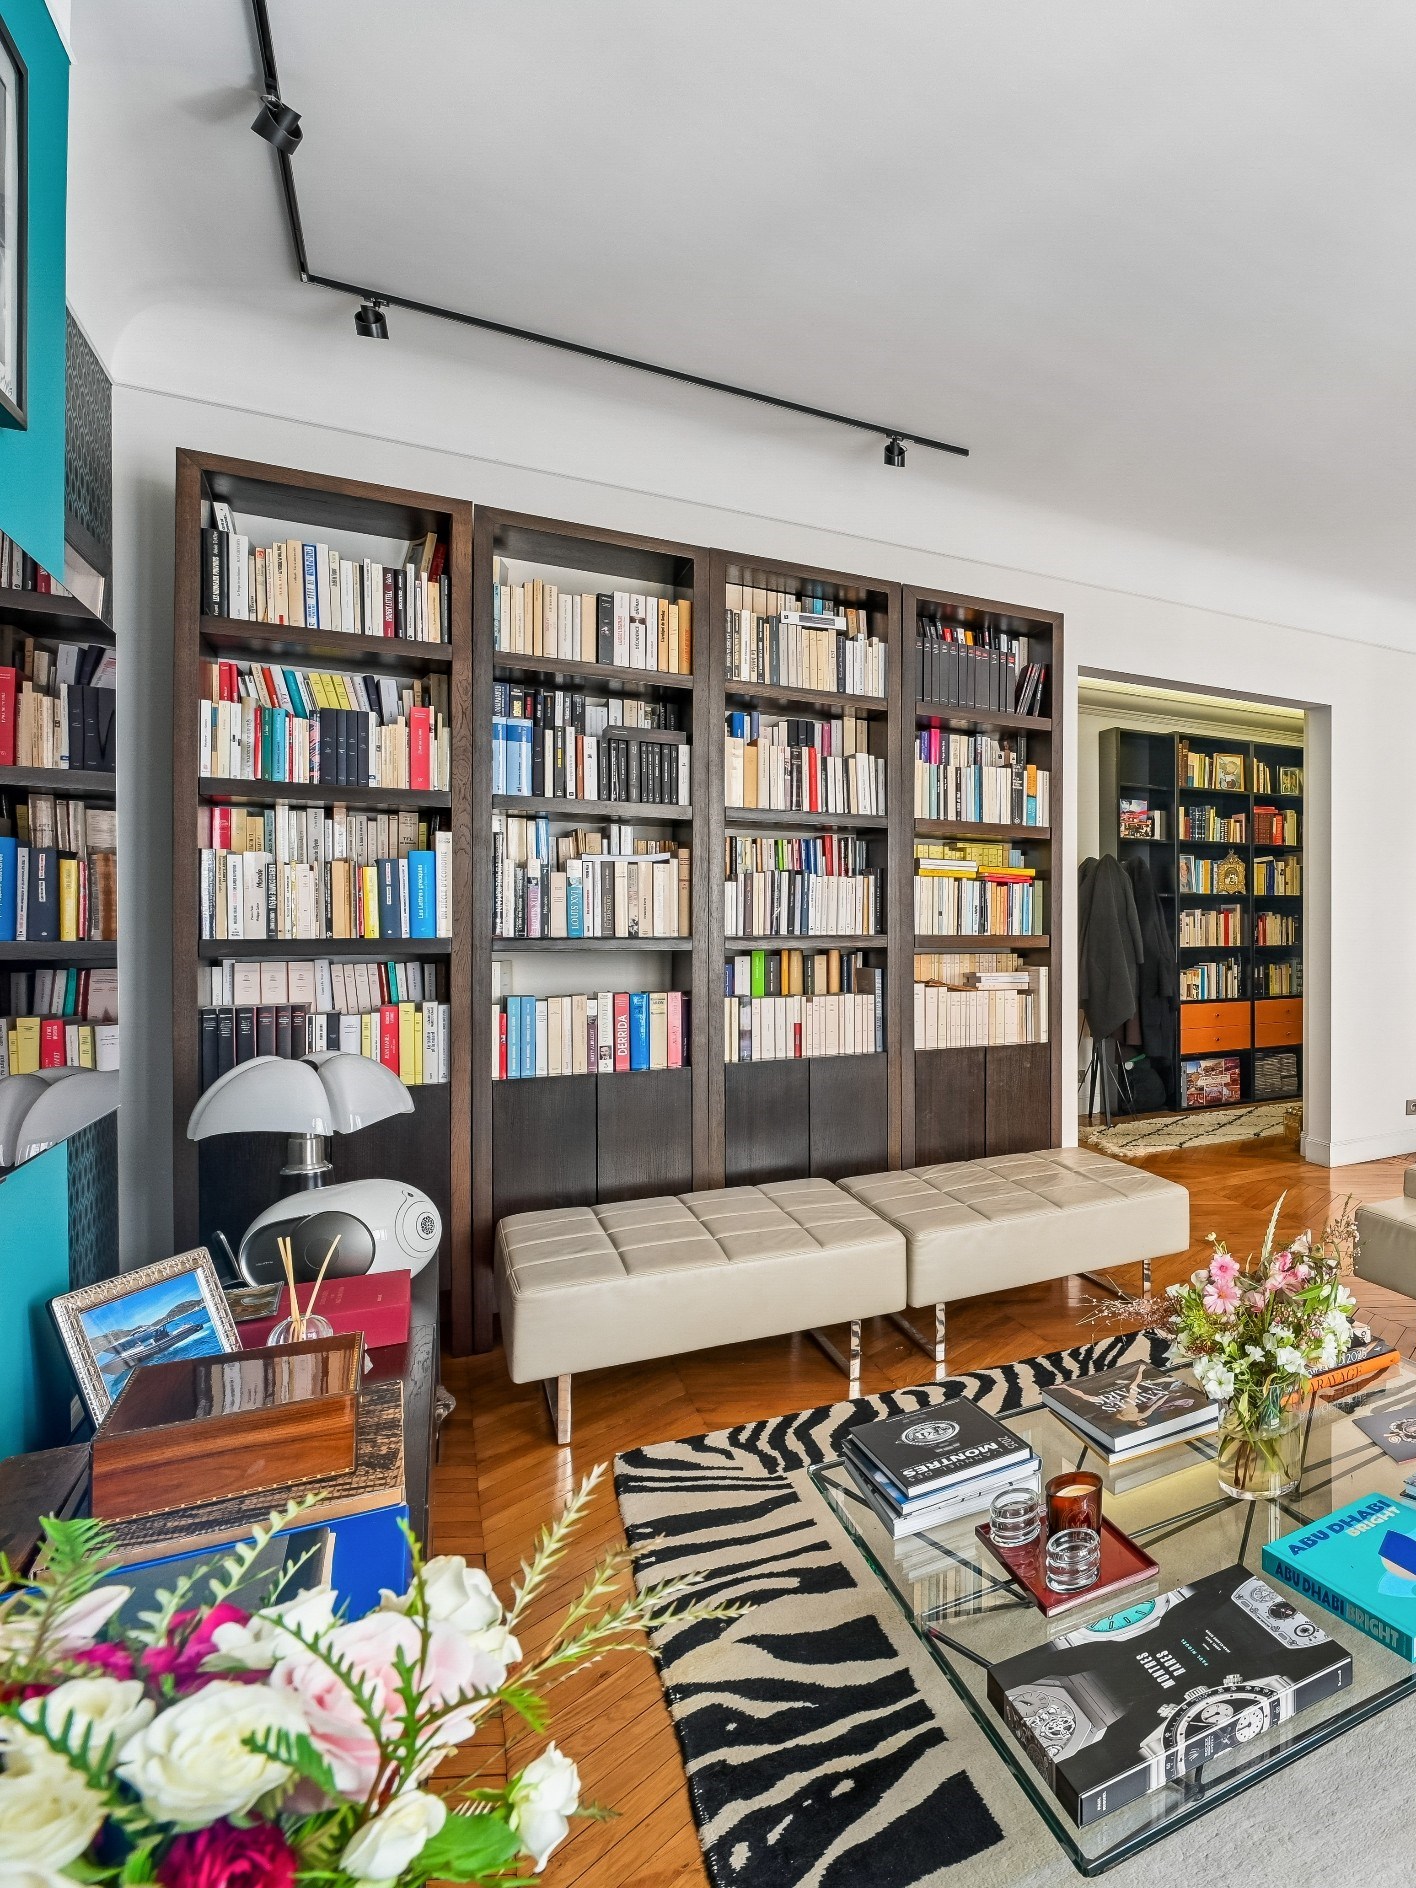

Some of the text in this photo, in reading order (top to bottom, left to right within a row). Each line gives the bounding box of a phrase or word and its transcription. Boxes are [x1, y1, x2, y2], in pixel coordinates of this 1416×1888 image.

[571, 890, 579, 929] LOUIS XVI
[617, 1014, 628, 1056] DERRIDA
[902, 1442, 999, 1478] MONTRES
[999, 1436, 1019, 1449] 2025
[1288, 1499, 1392, 1556] ABU DHABI
[1344, 1506, 1401, 1538] BRIGHT
[1275, 1561, 1399, 1648] ABU DHABI BRIGHT
[1136, 1652, 1176, 1689] MONTRES
[1156, 1650, 1186, 1677] RARES
[1196, 1654, 1209, 1667] PAUL
